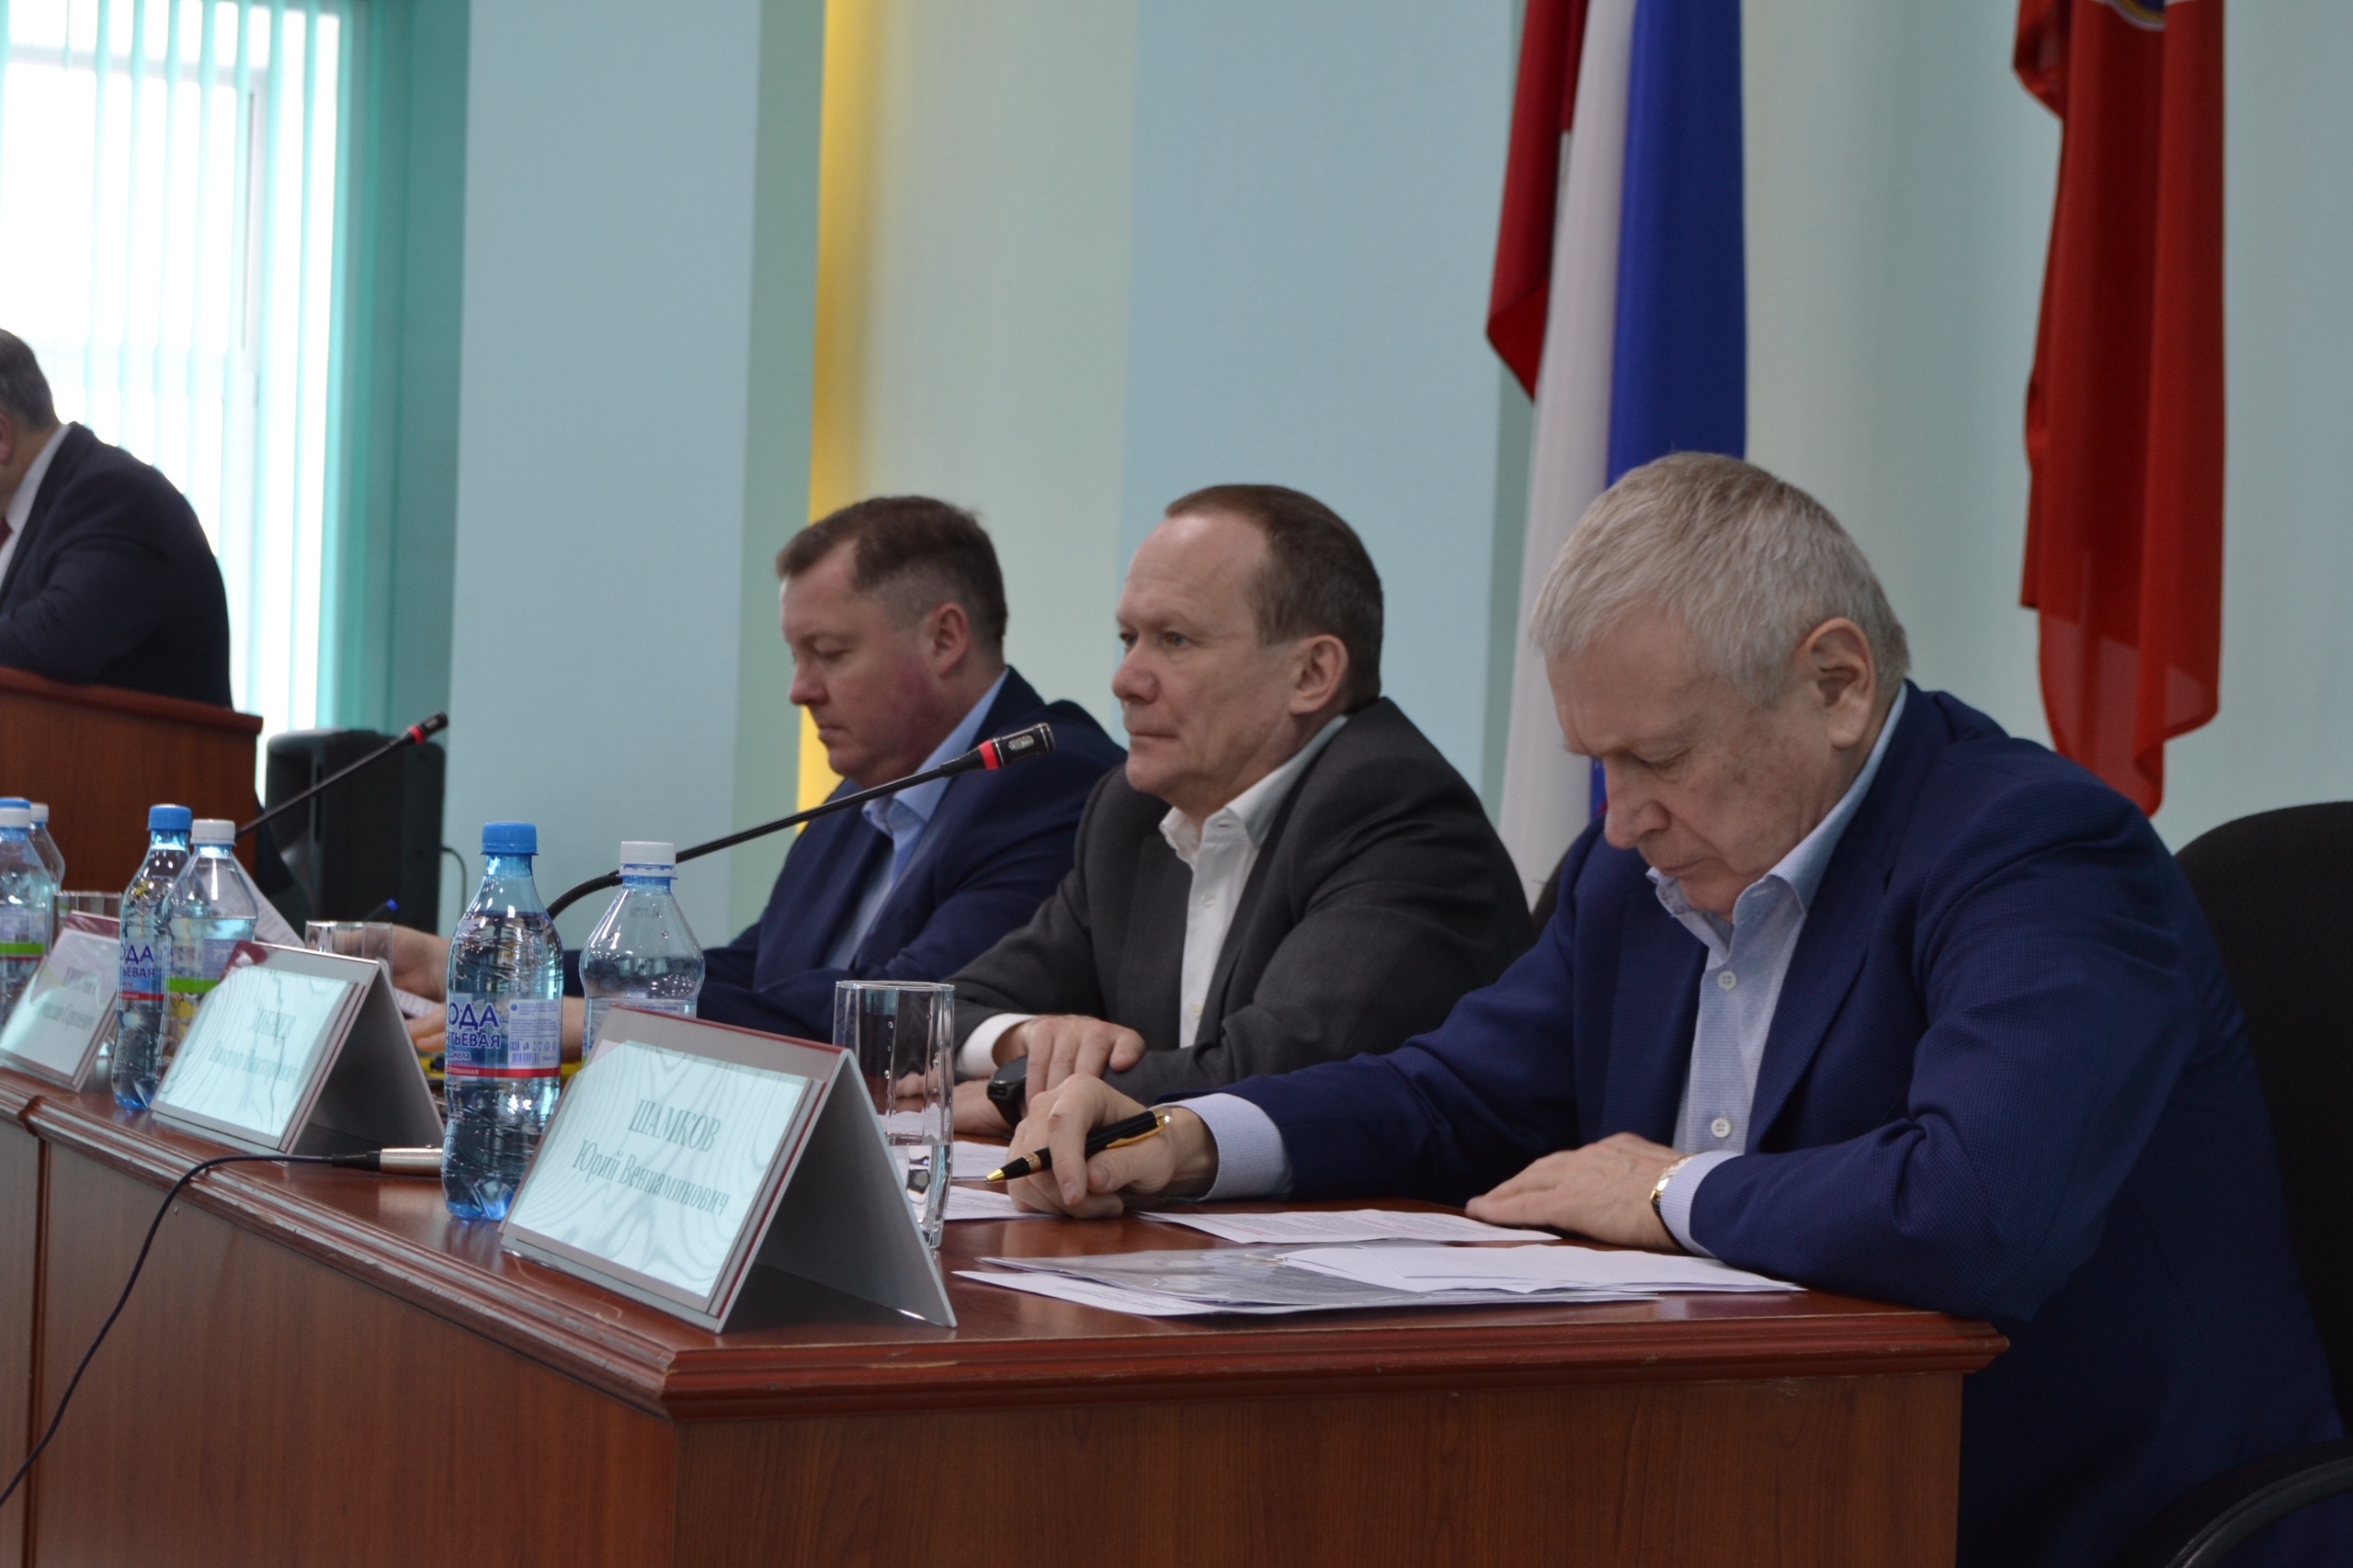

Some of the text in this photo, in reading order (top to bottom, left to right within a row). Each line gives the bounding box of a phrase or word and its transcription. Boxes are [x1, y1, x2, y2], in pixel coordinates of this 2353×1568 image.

[448, 1031, 501, 1049] ТЬЕВАЯ
[628, 1098, 722, 1153] ШАМКОВ
[572, 1139, 732, 1217] Юрий Вениаминович
